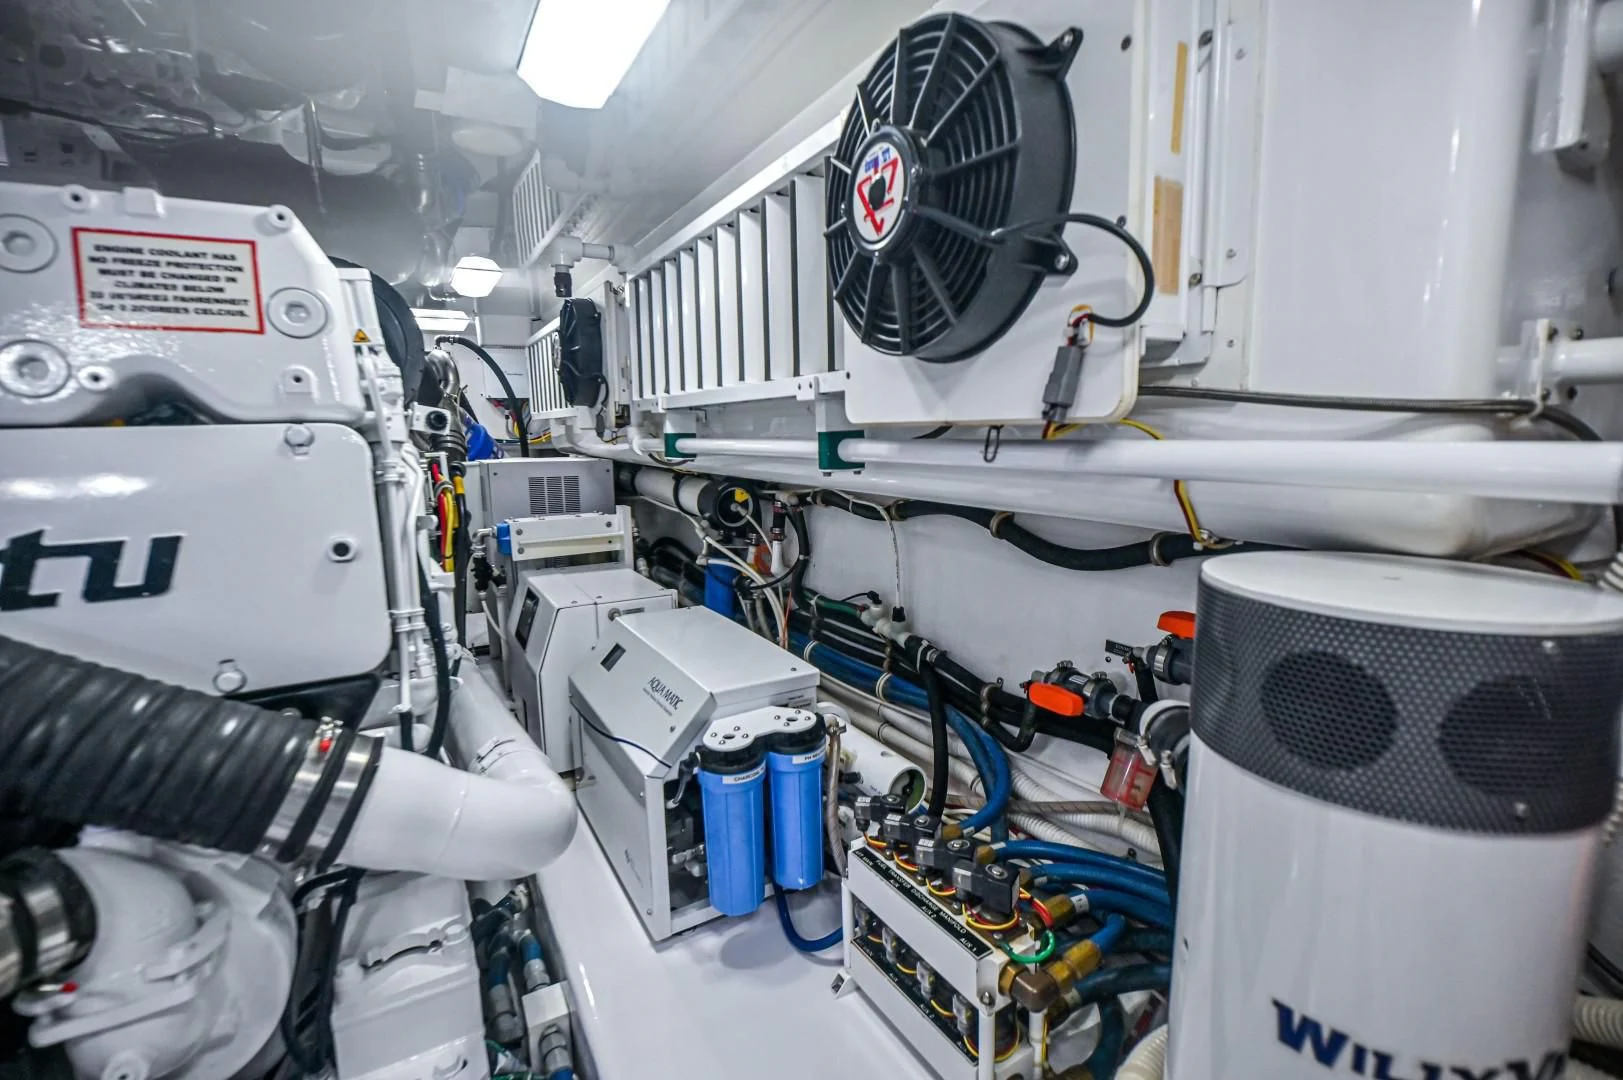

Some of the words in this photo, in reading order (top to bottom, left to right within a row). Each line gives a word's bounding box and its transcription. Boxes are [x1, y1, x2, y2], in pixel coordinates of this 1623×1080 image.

[94, 244, 143, 254] ENGINE
[148, 247, 208, 259] COOLANT
[112, 257, 160, 267] FREEZE
[166, 261, 244, 272] PROTECTION
[98, 268, 134, 276] MUST
[140, 270, 156, 278] BE
[160, 271, 221, 282] CHANGED
[114, 280, 177, 291] CLIMATES
[182, 285, 225, 293] BELOW
[940, 911, 967, 934] MANIFOLD
